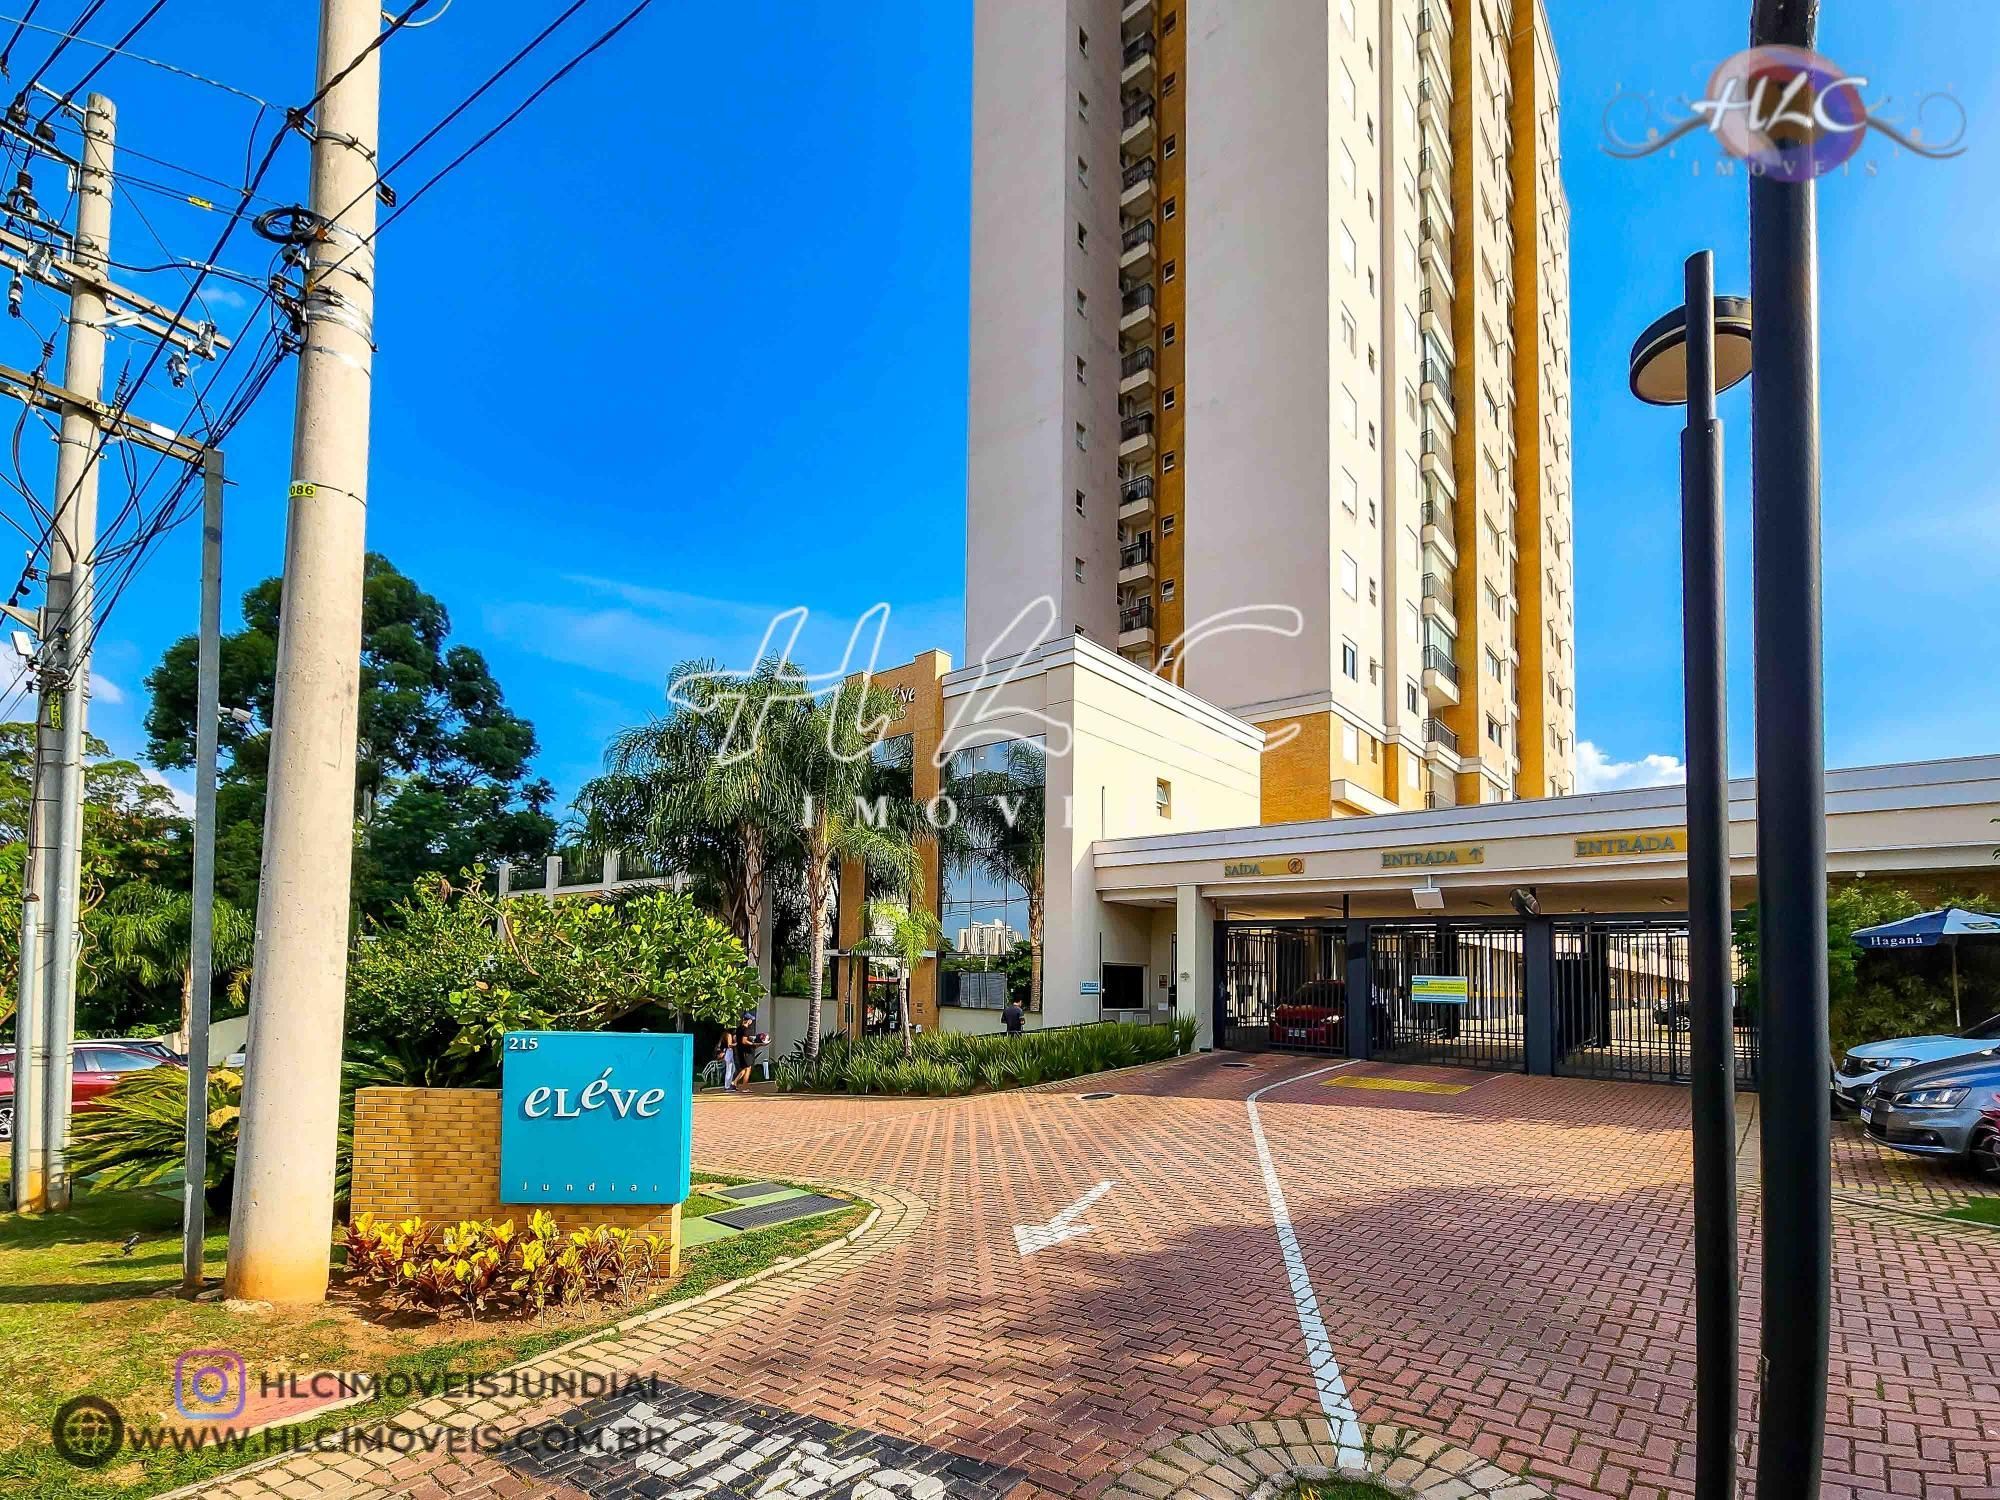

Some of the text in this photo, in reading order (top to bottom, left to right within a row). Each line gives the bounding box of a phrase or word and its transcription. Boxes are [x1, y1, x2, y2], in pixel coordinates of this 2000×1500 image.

[1575, 835, 1676, 854] ENTRADA
[1382, 850, 1458, 866] ENTRADA
[1224, 863, 1261, 877] SAÍDA
[1870, 933, 1923, 947] Haganá
[508, 1037, 539, 1050] 215
